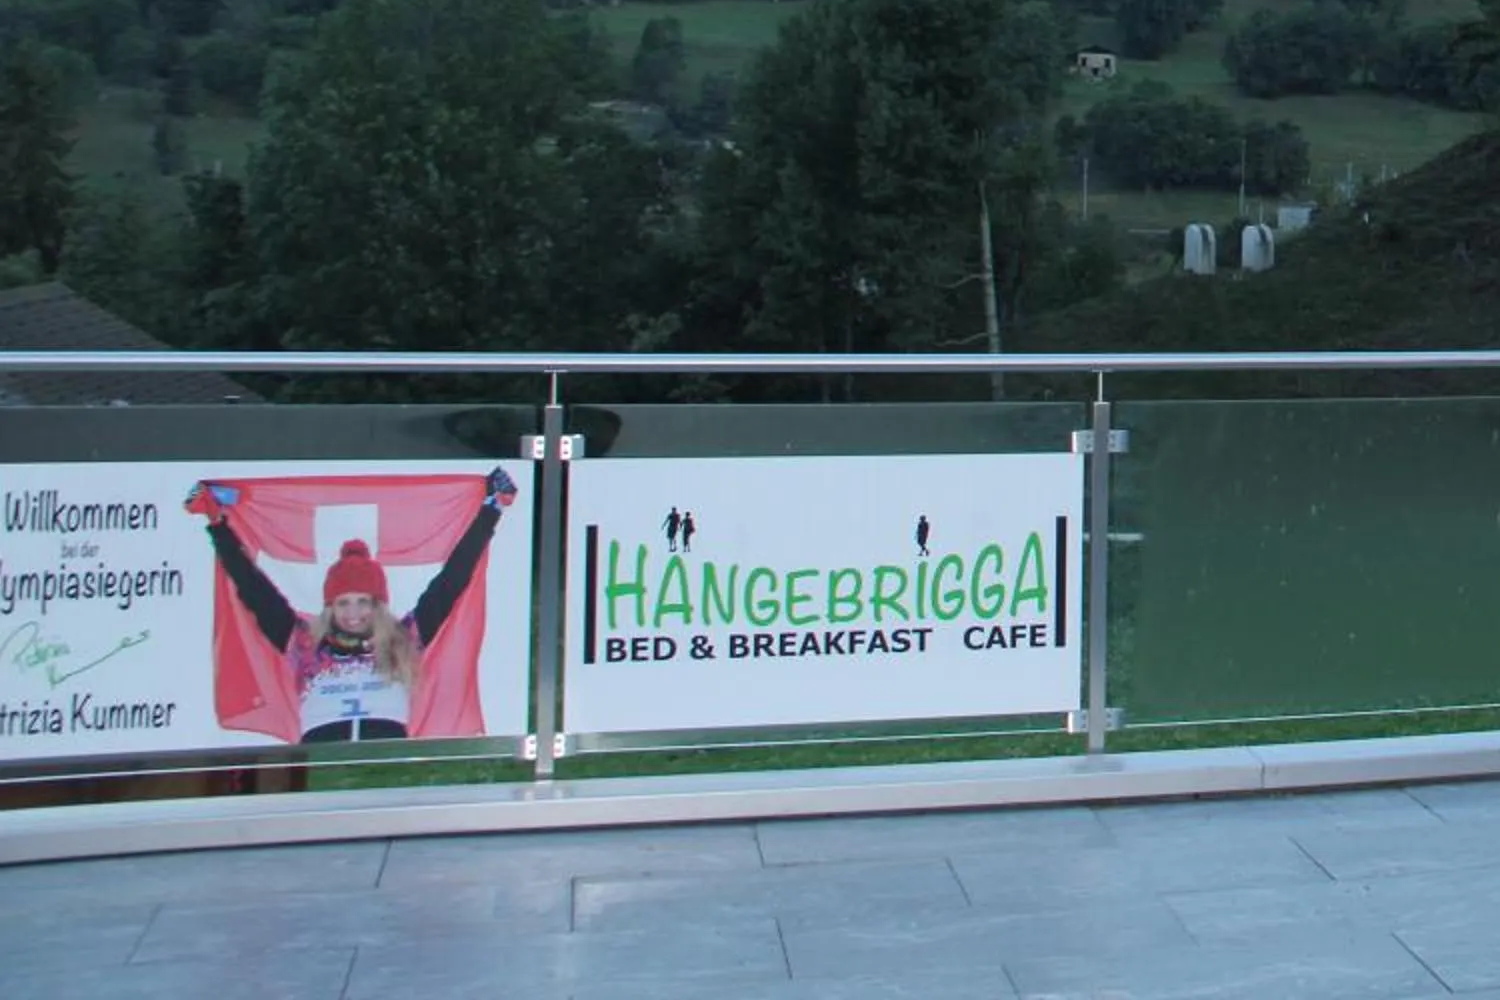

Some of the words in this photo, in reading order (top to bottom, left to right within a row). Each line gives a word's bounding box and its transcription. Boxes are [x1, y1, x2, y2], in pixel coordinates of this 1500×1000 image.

[5, 489, 158, 533] Willkommen
[0, 560, 183, 615] ympiasiegerin
[605, 637, 677, 662] BED
[689, 635, 716, 660] &
[728, 628, 933, 658] BREAKFAST
[963, 624, 1048, 650] CAFE
[70, 692, 176, 733] Kummer
